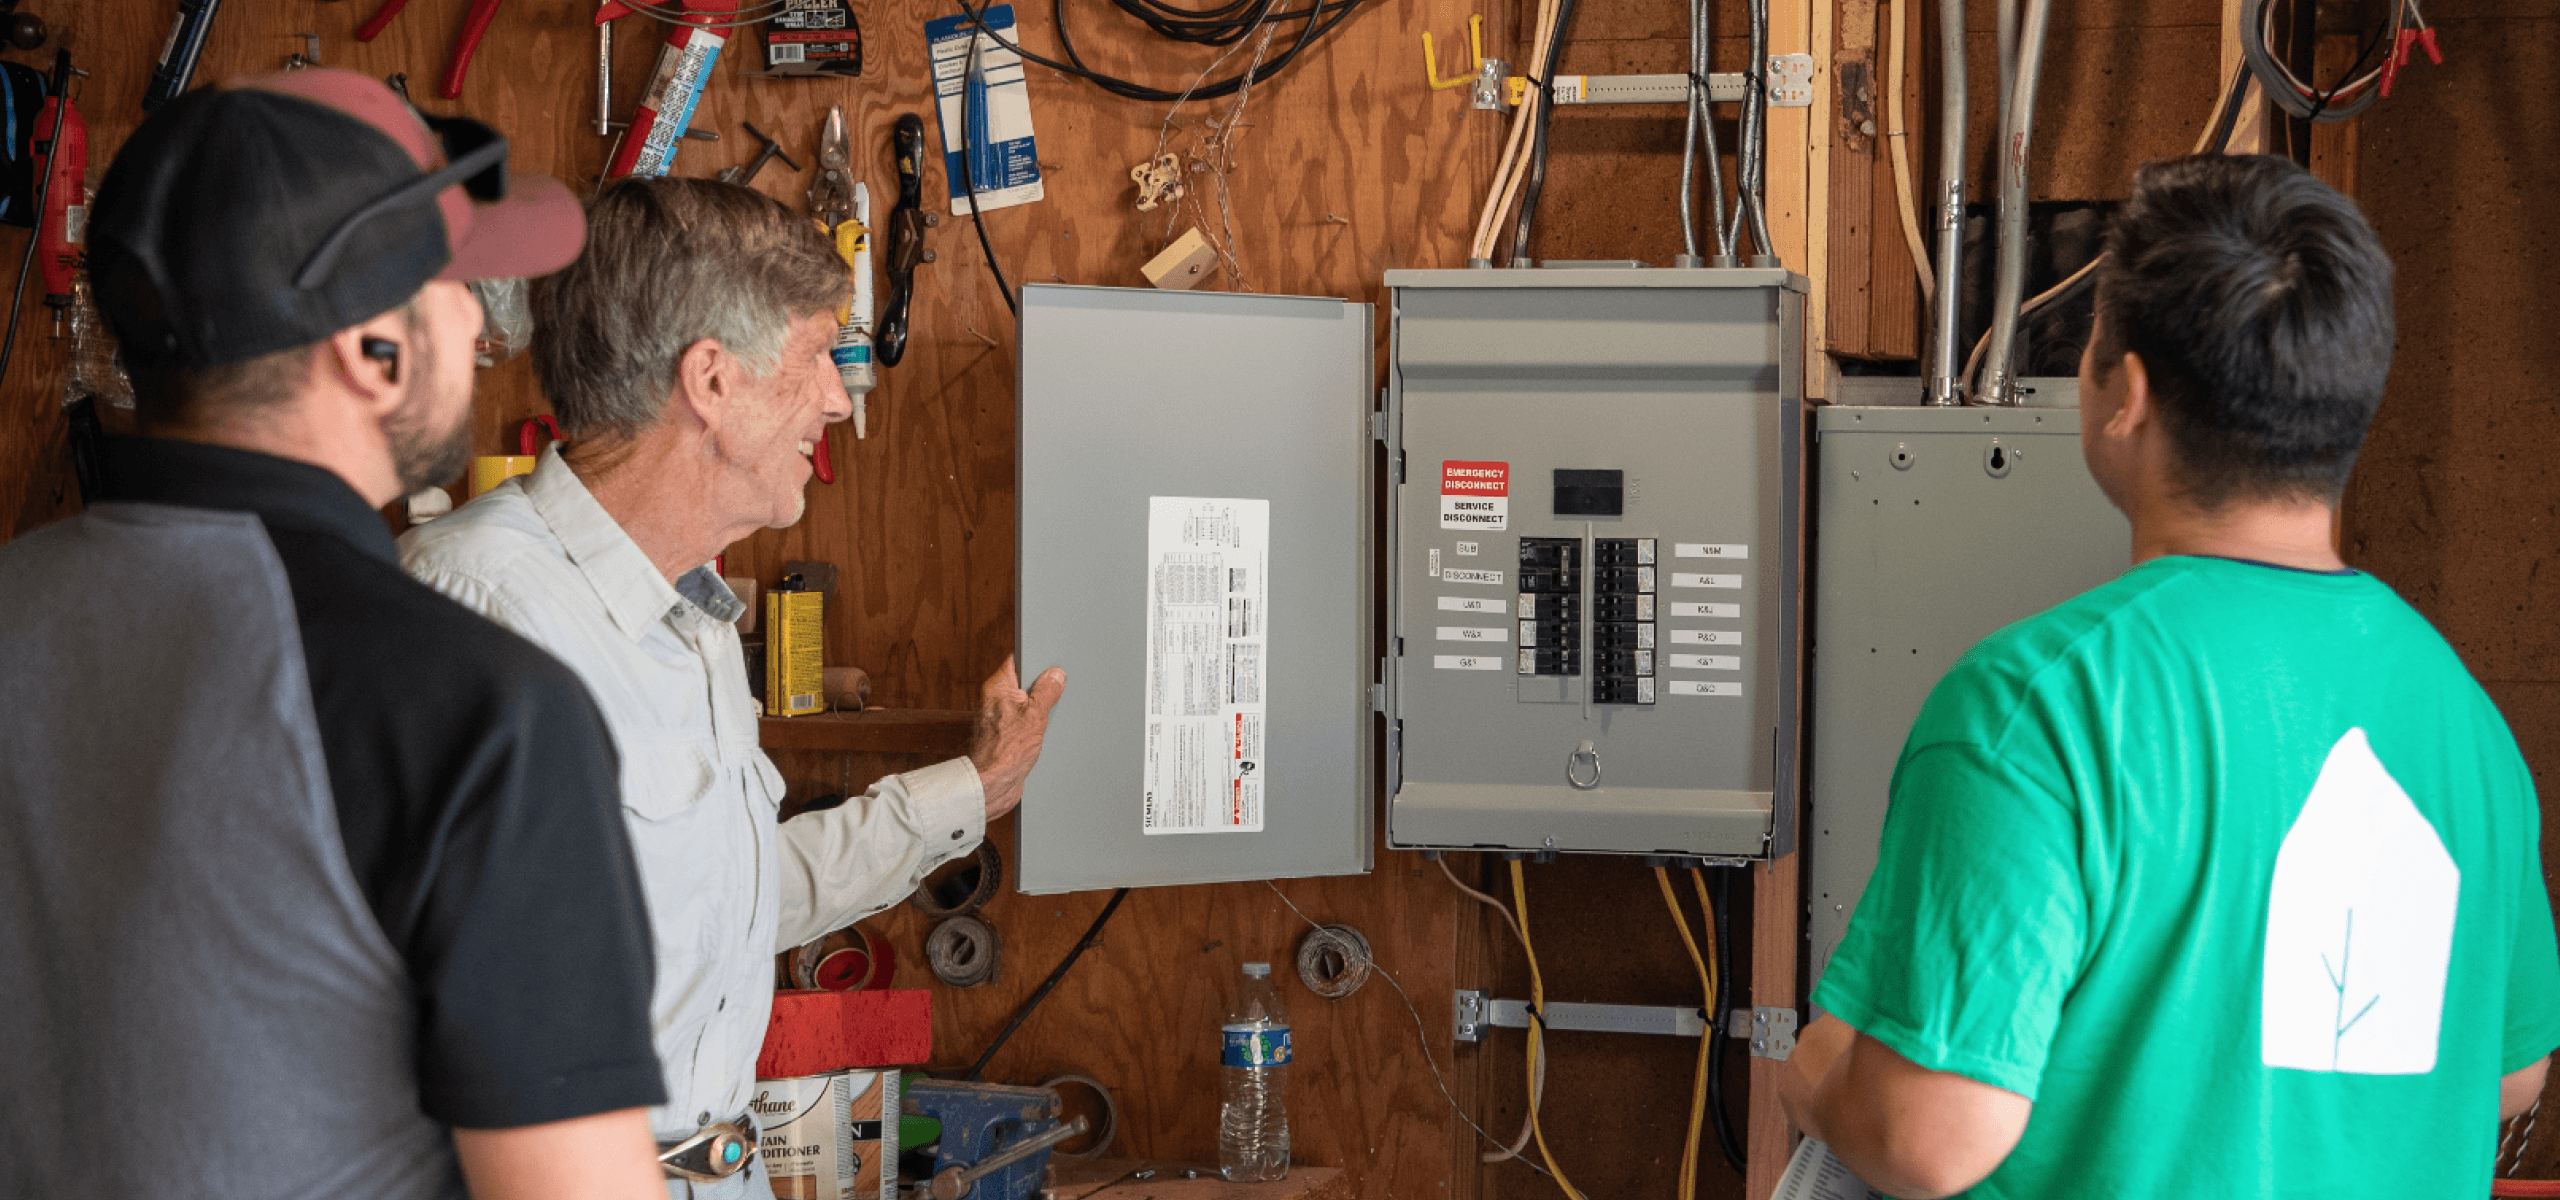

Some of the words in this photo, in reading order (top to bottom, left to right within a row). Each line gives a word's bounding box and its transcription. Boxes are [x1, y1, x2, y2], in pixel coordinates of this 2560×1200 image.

[1446, 467, 1505, 479] EMERGENCY
[1445, 480, 1506, 491] DISCONNECT
[1454, 501, 1495, 512] SERVICE
[1443, 513, 1504, 523] DISCONNECT
[1458, 543, 1477, 553] SUB
[1445, 570, 1502, 582] DISCONNECT
[1145, 791, 1154, 828] SIEMENS
[751, 1091, 796, 1114] thane
[761, 1136, 787, 1148] TAIN
[762, 1144, 821, 1159] DITIONER
